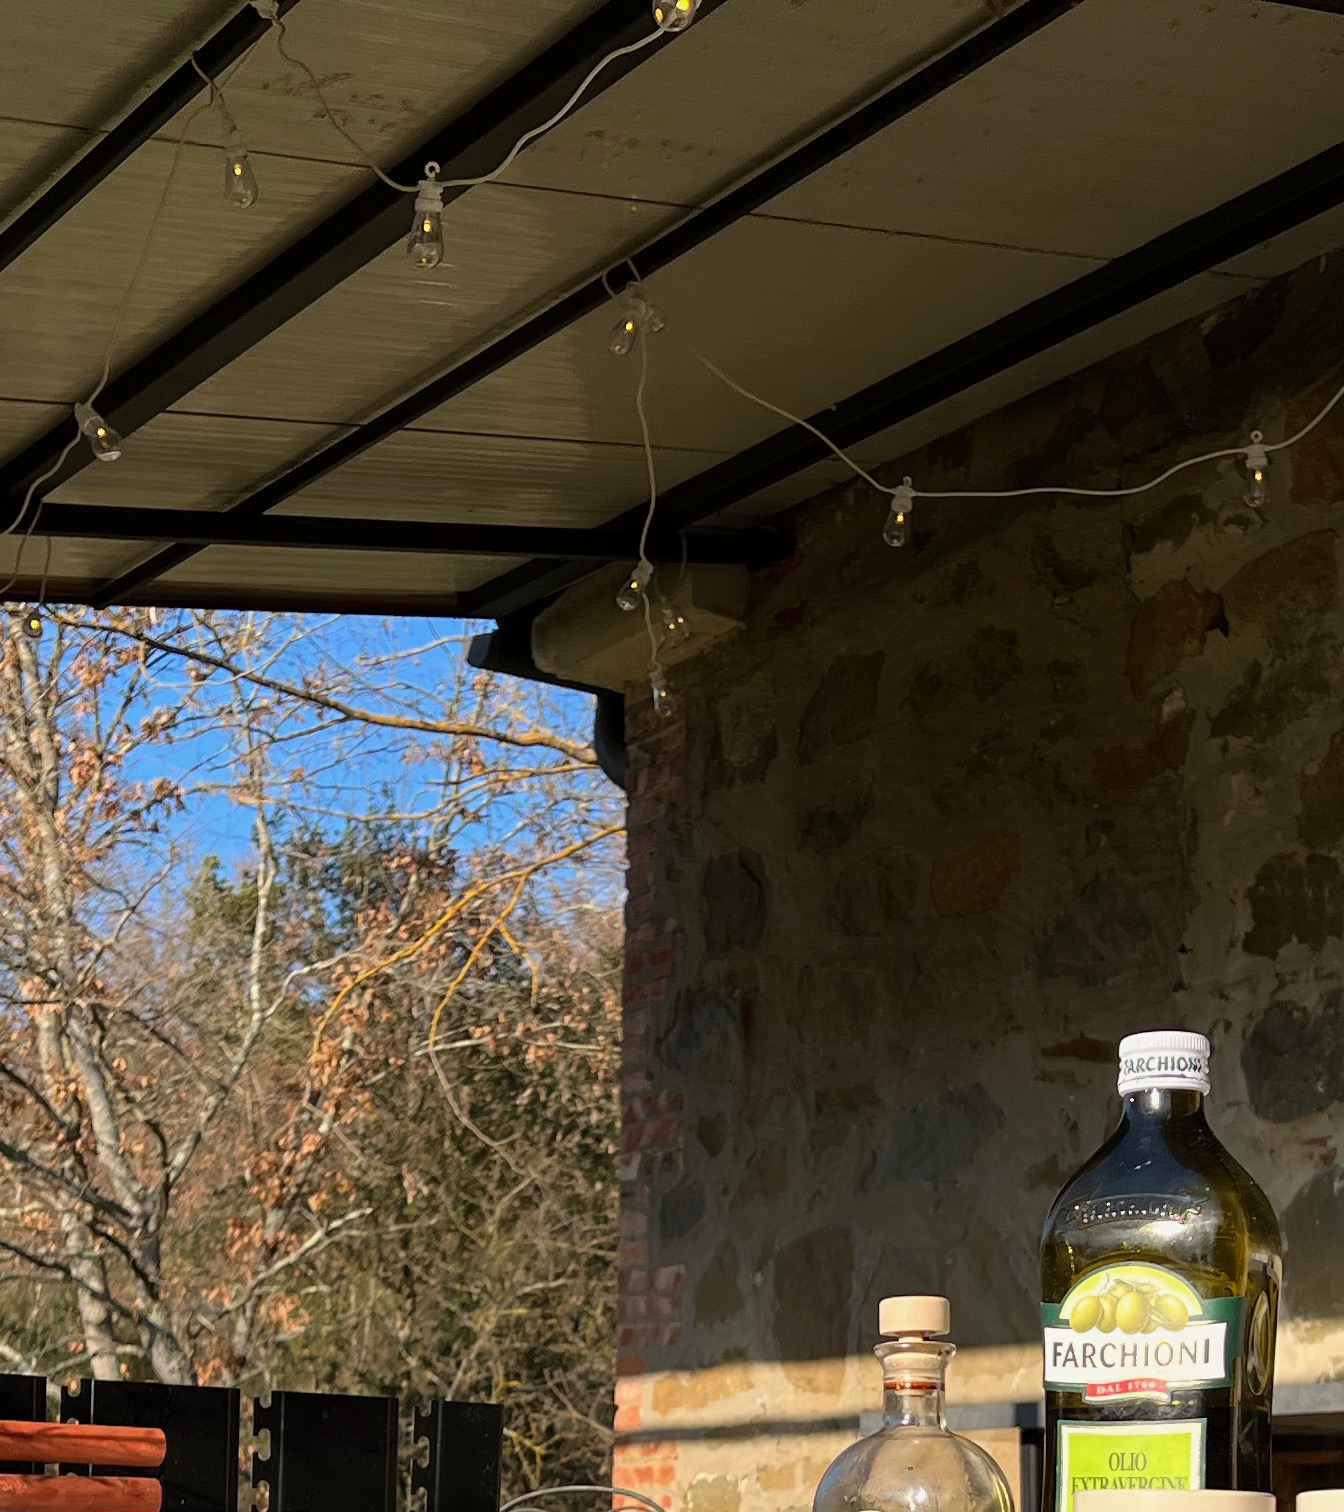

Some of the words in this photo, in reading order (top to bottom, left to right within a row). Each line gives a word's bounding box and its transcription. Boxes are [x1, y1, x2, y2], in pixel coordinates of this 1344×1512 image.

[1052, 1338, 1210, 1368] FARCHIONI
[1096, 1385, 1122, 1395] DAL
[1108, 1451, 1147, 1472] OLIO
